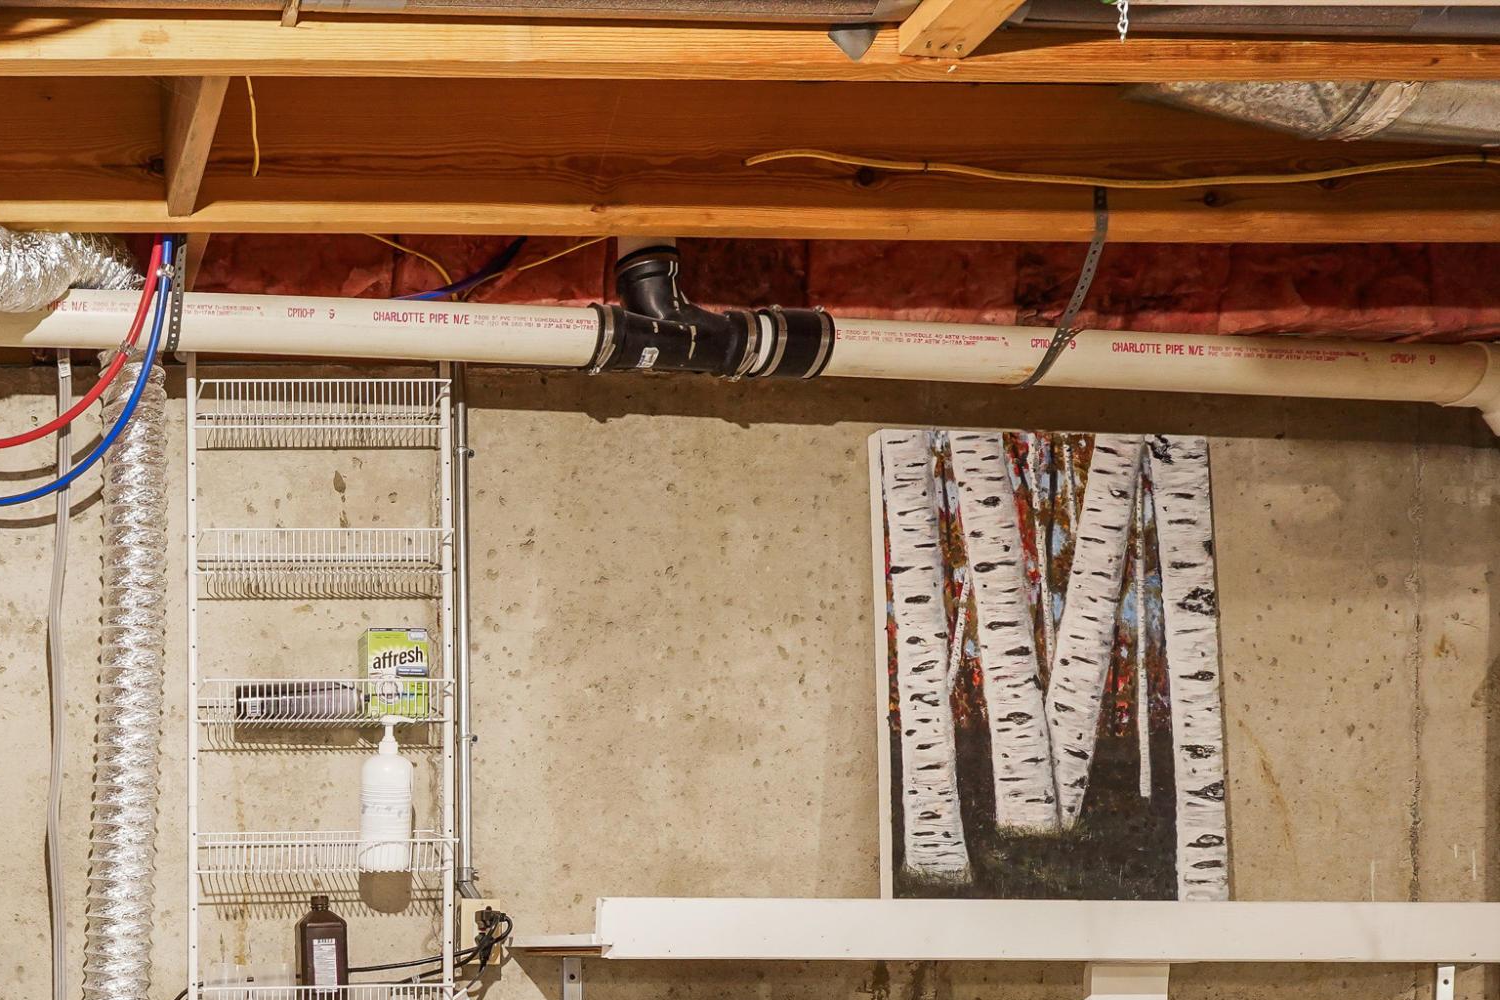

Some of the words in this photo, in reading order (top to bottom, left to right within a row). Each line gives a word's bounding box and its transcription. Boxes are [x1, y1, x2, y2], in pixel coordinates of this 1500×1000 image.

[373, 311, 425, 324] CHARLOTTE
[429, 312, 449, 324] PIPE
[453, 314, 470, 326] N/E
[1112, 342, 1161, 355] CHARLOTTE
[1165, 344, 1185, 356] PIPE
[1188, 345, 1204, 356] N/E
[373, 646, 423, 669] affresh
